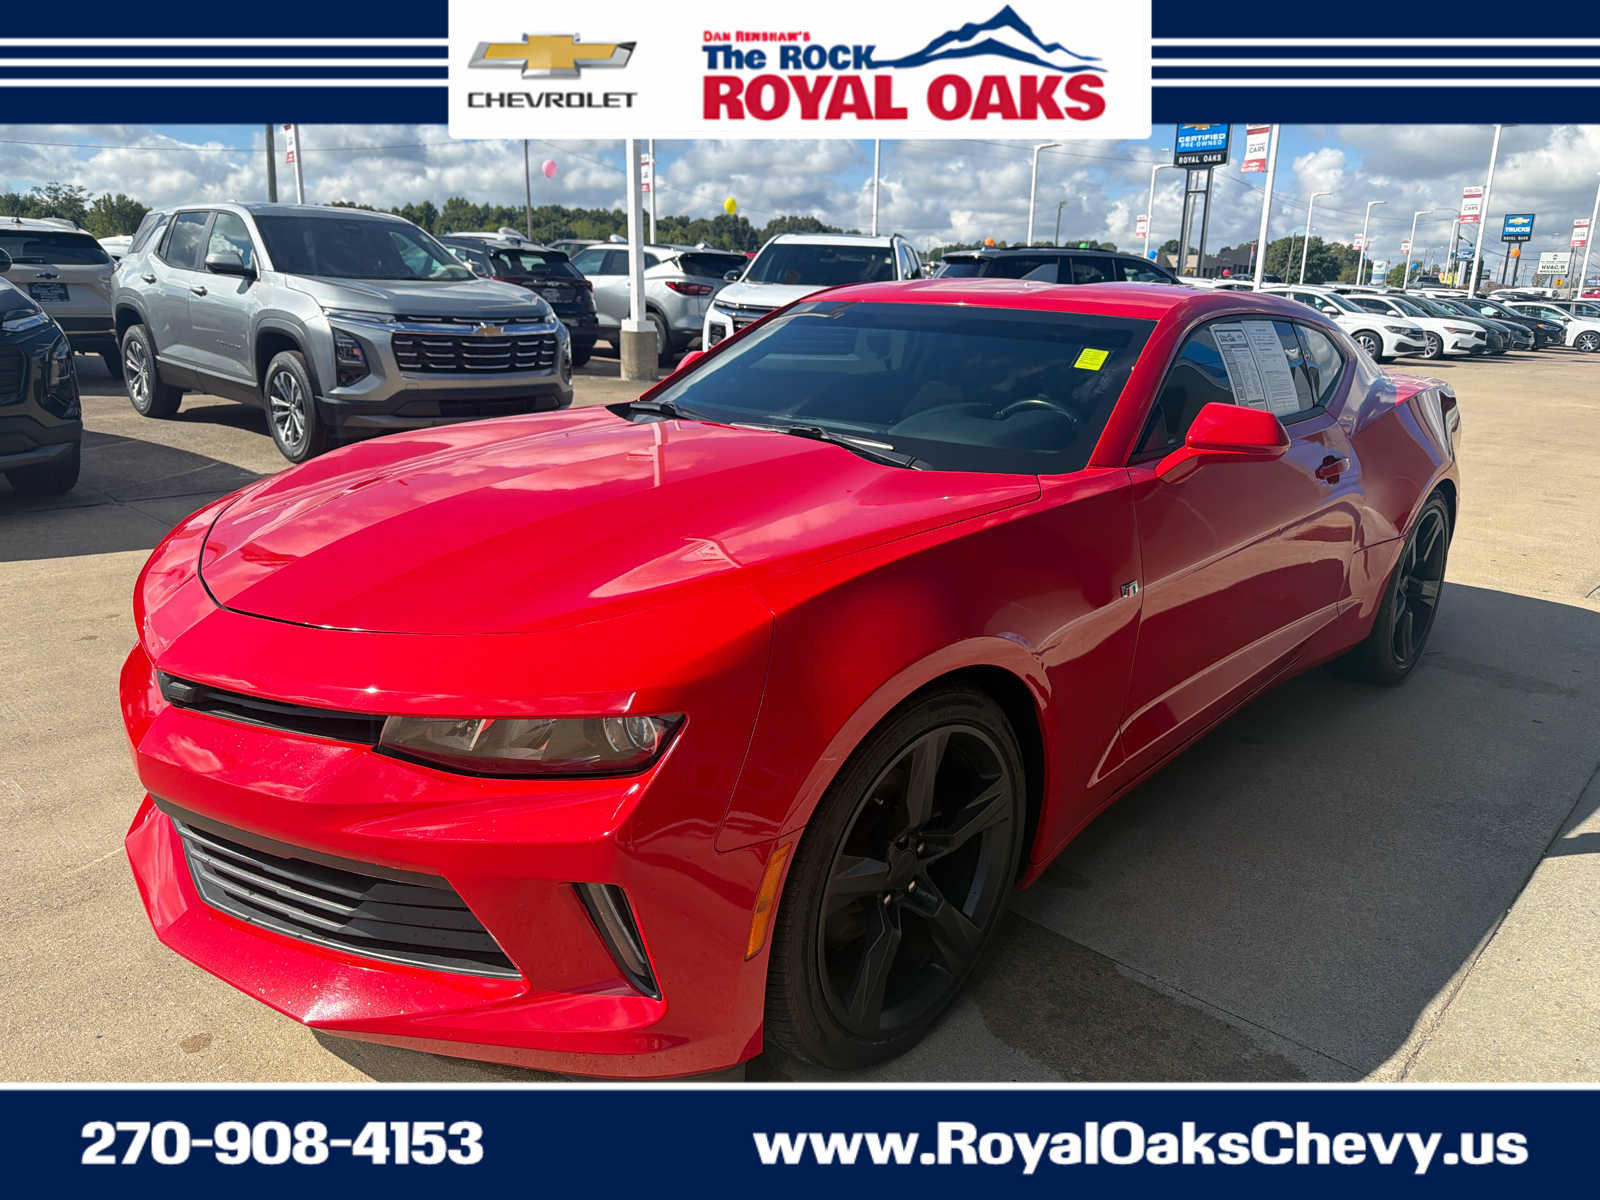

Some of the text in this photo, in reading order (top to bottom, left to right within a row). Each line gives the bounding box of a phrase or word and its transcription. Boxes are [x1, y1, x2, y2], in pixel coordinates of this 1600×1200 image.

[1178, 133, 1226, 143] CERTIFIED
[1180, 140, 1223, 148] PRE-OWNED
[1178, 154, 1222, 164] ROYAL OAKS
